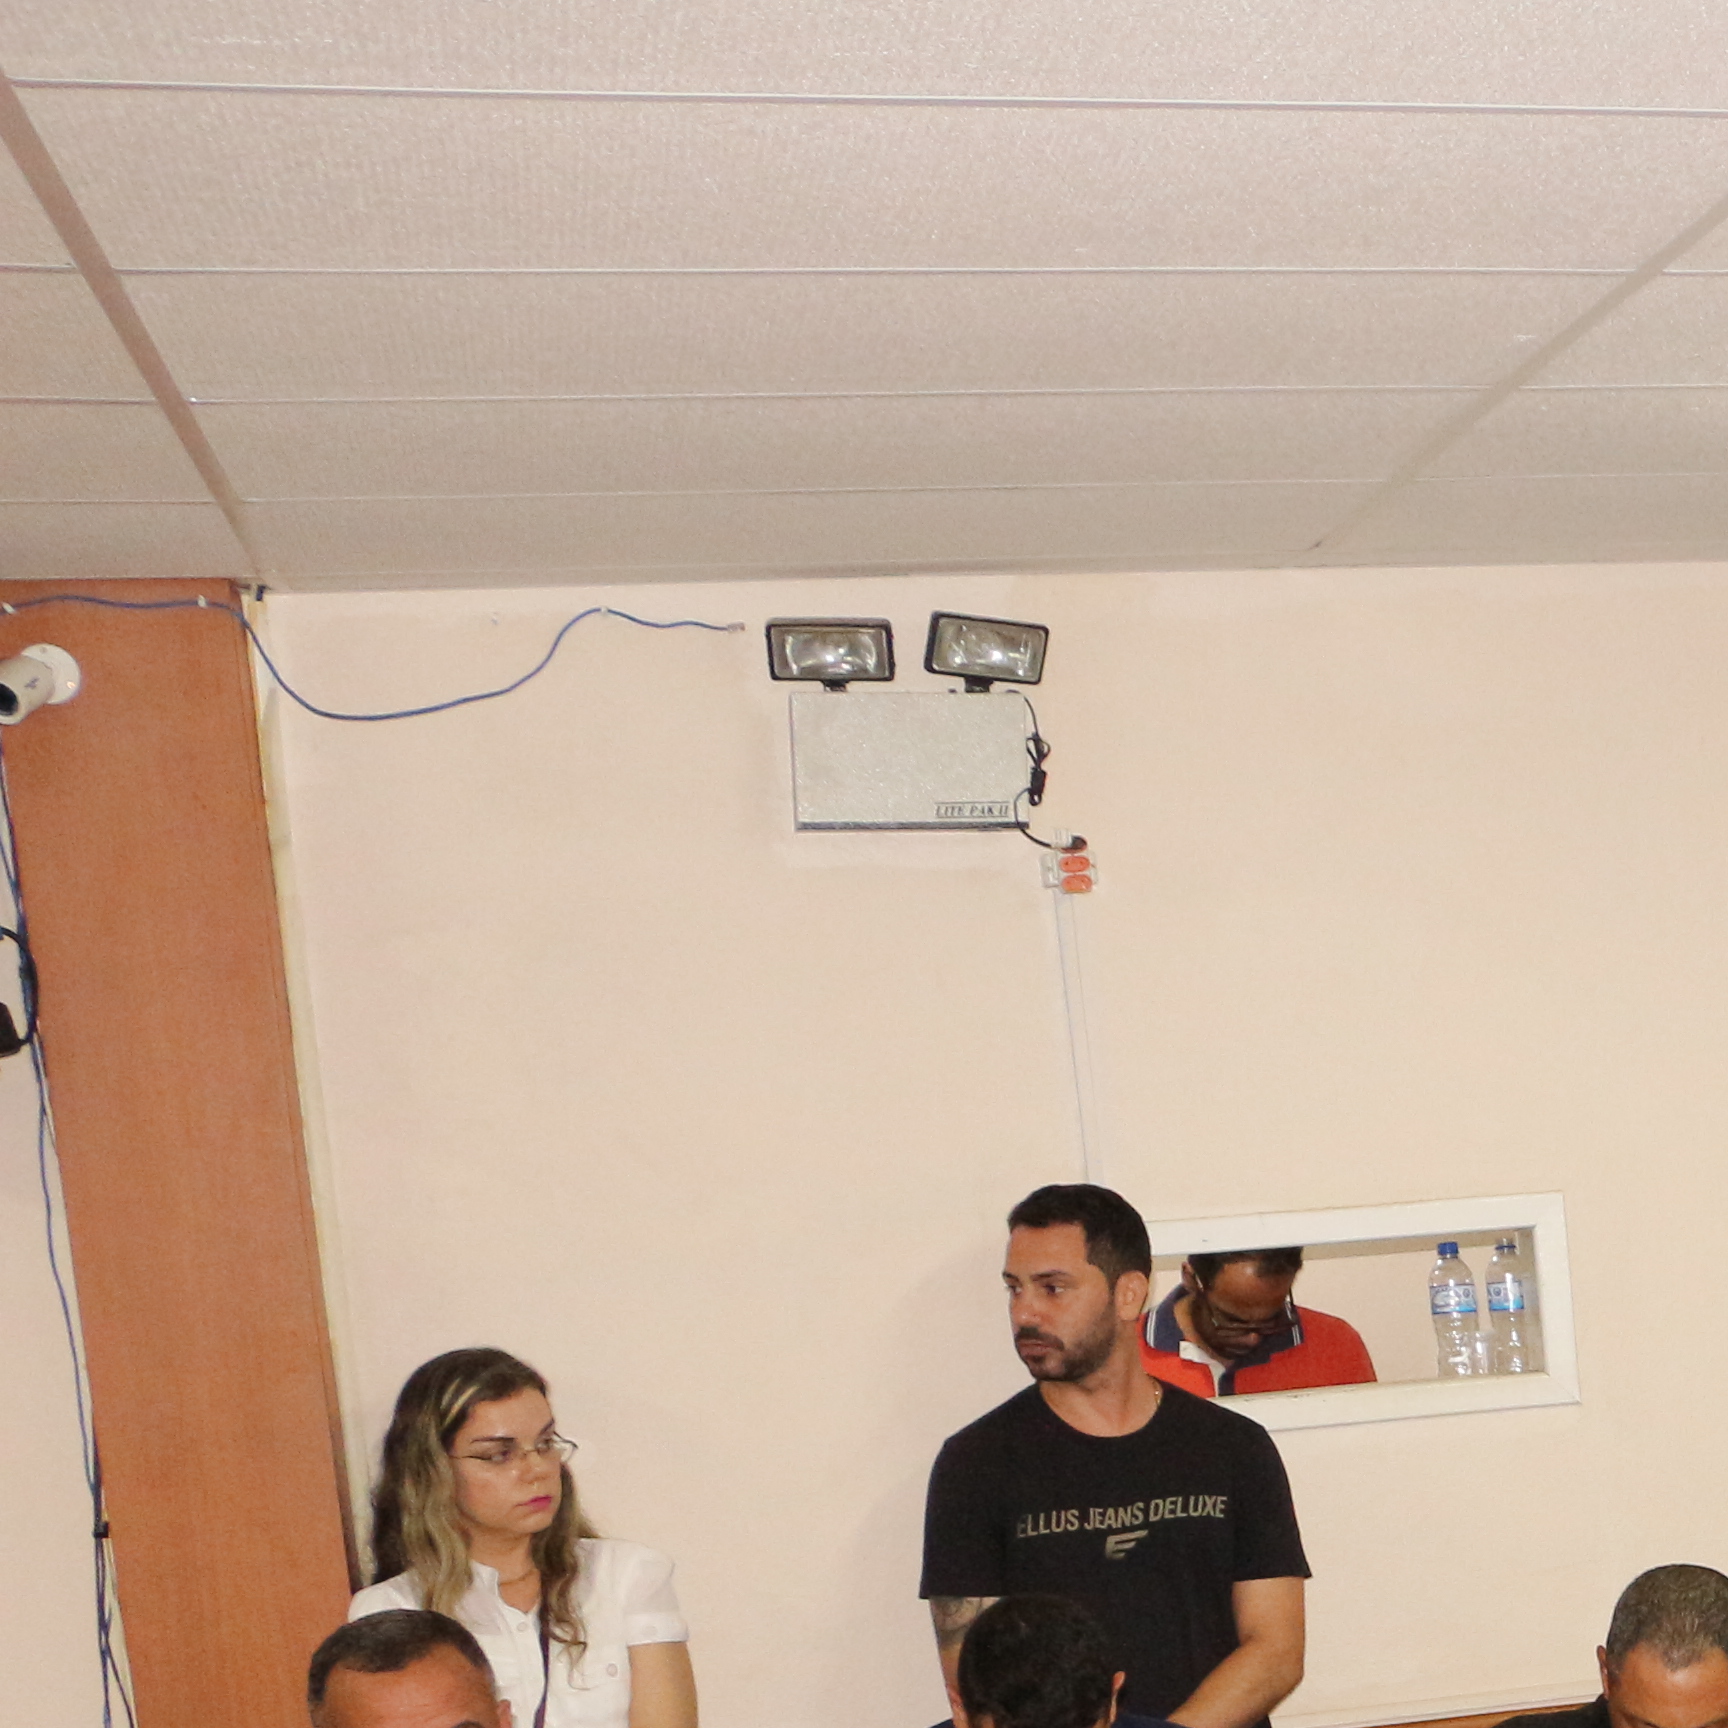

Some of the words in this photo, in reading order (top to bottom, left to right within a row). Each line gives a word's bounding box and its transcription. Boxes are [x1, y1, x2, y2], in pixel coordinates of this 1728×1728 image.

[1017, 1508, 1080, 1539] ELLUS
[1083, 1501, 1145, 1531] JEANS
[1148, 1495, 1228, 1522] DELUXE
